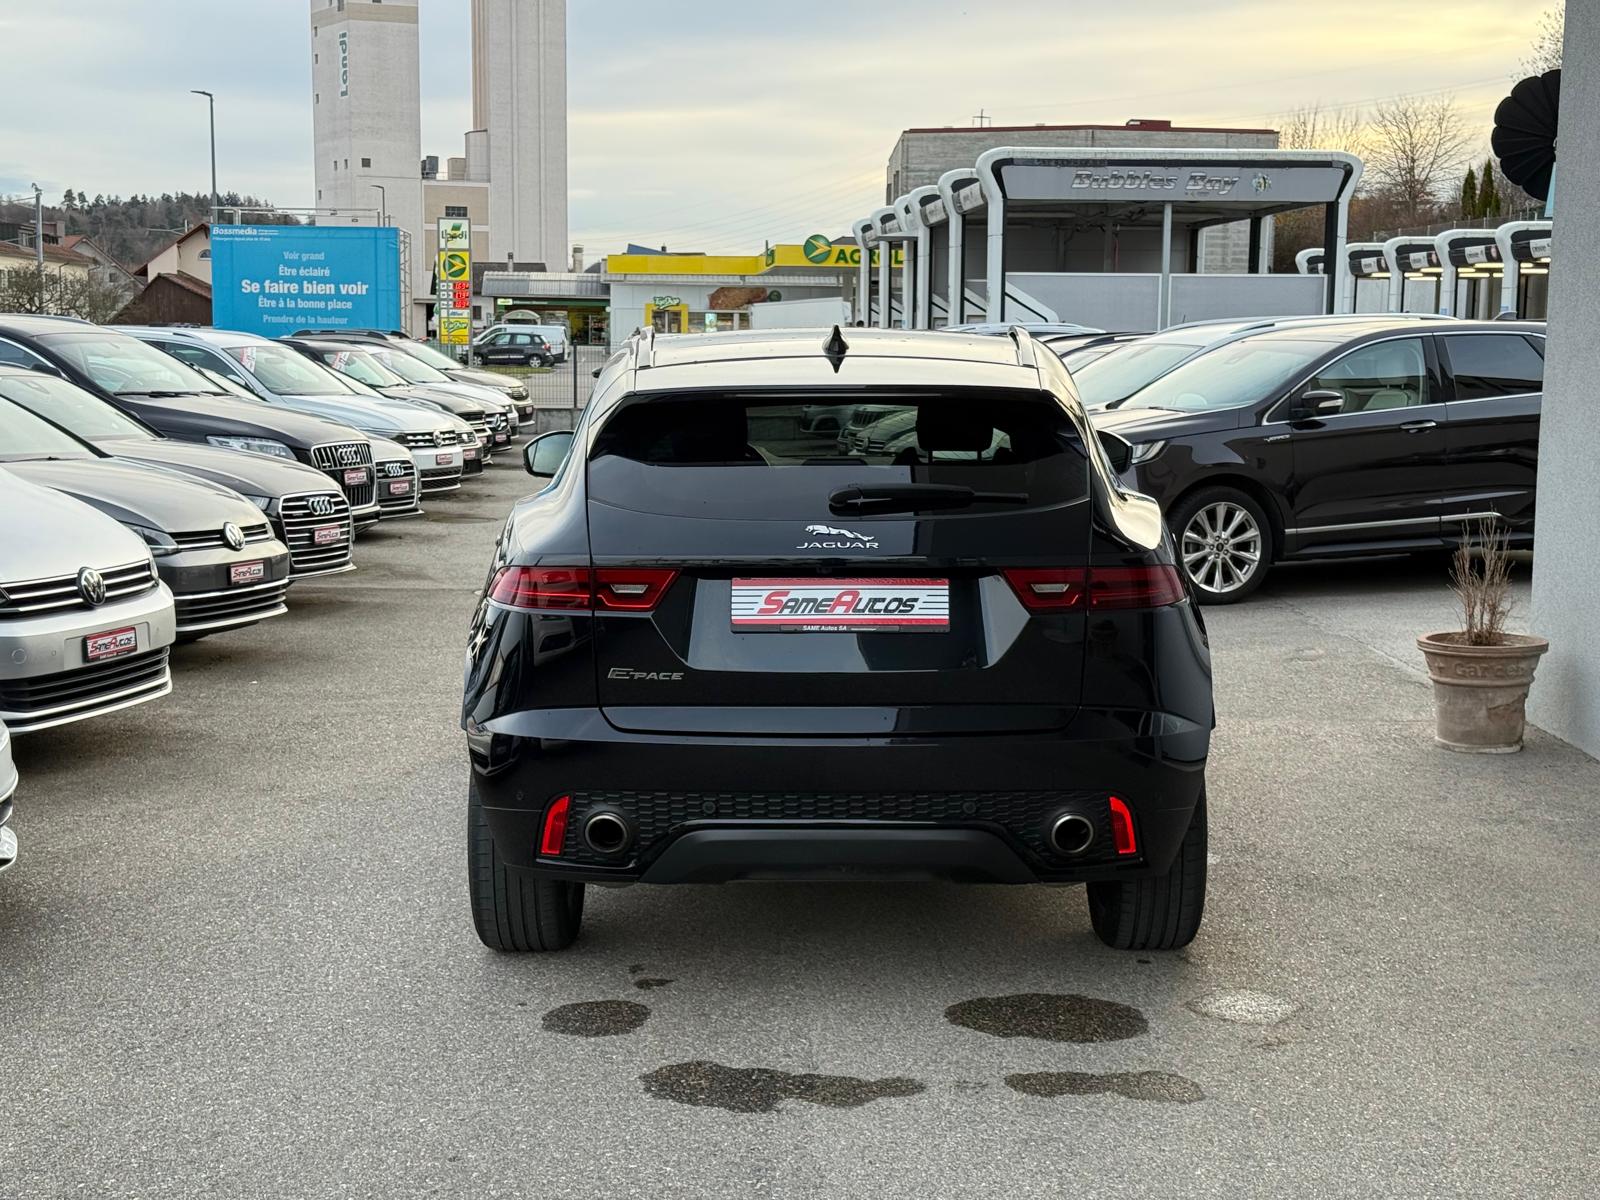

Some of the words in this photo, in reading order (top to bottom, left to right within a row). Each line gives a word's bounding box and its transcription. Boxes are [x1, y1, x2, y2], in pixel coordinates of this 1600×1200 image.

[339, 32, 348, 97] Landi
[1072, 170, 1178, 189] Bubbles
[1185, 172, 1239, 195] Bay
[212, 226, 258, 236] Bossmedia
[283, 251, 299, 260] Voir
[301, 252, 325, 262] grand
[278, 264, 297, 276] Être
[299, 266, 330, 277] éclairé
[241, 279, 260, 293] Se
[264, 280, 299, 294] faire
[303, 281, 336, 295] bien
[339, 282, 369, 295] voir
[258, 295, 277, 308] Être
[278, 297, 285, 308] à
[286, 298, 296, 308] la
[297, 298, 326, 309] bonne
[327, 299, 353, 311] place
[263, 314, 294, 324] Prendre
[295, 315, 307, 324] de
[307, 315, 317, 324] la
[318, 316, 349, 325] hauteur
